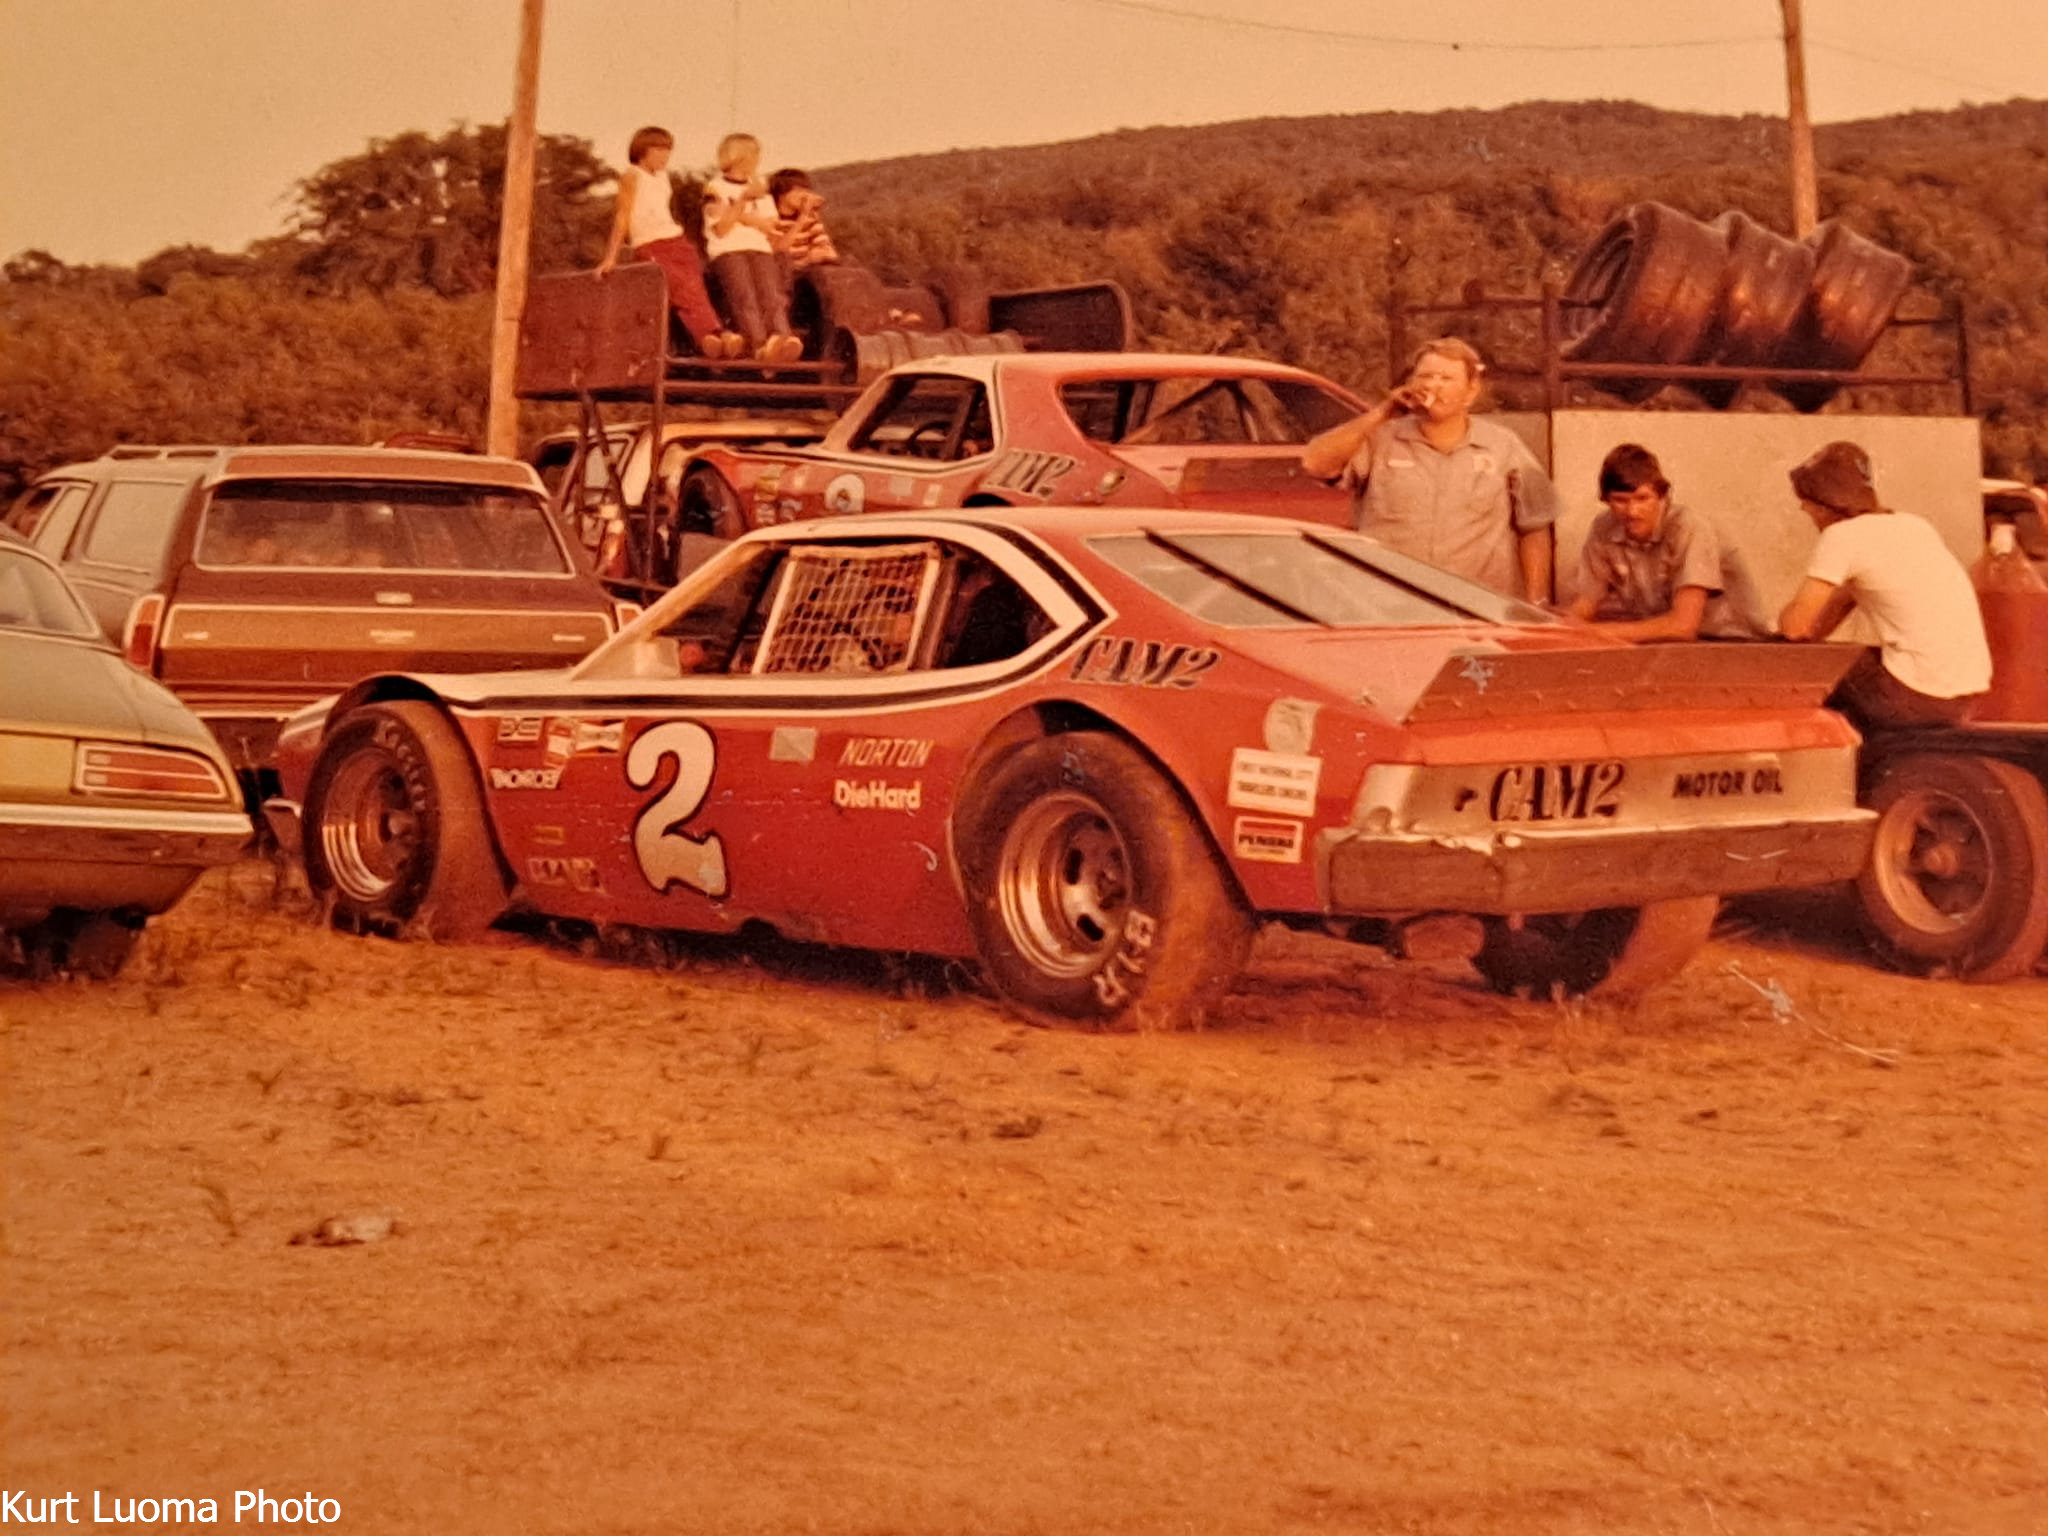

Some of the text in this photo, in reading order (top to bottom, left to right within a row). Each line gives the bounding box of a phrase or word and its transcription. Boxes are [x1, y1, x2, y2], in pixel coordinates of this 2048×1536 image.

[1070, 636, 1221, 688] CAM2
[838, 738, 934, 767] NORTON
[834, 779, 922, 810] DieHard
[1490, 763, 1625, 821] CAM2
[1672, 768, 1782, 798] MOTOR OIL
[627, 720, 729, 899] 2
